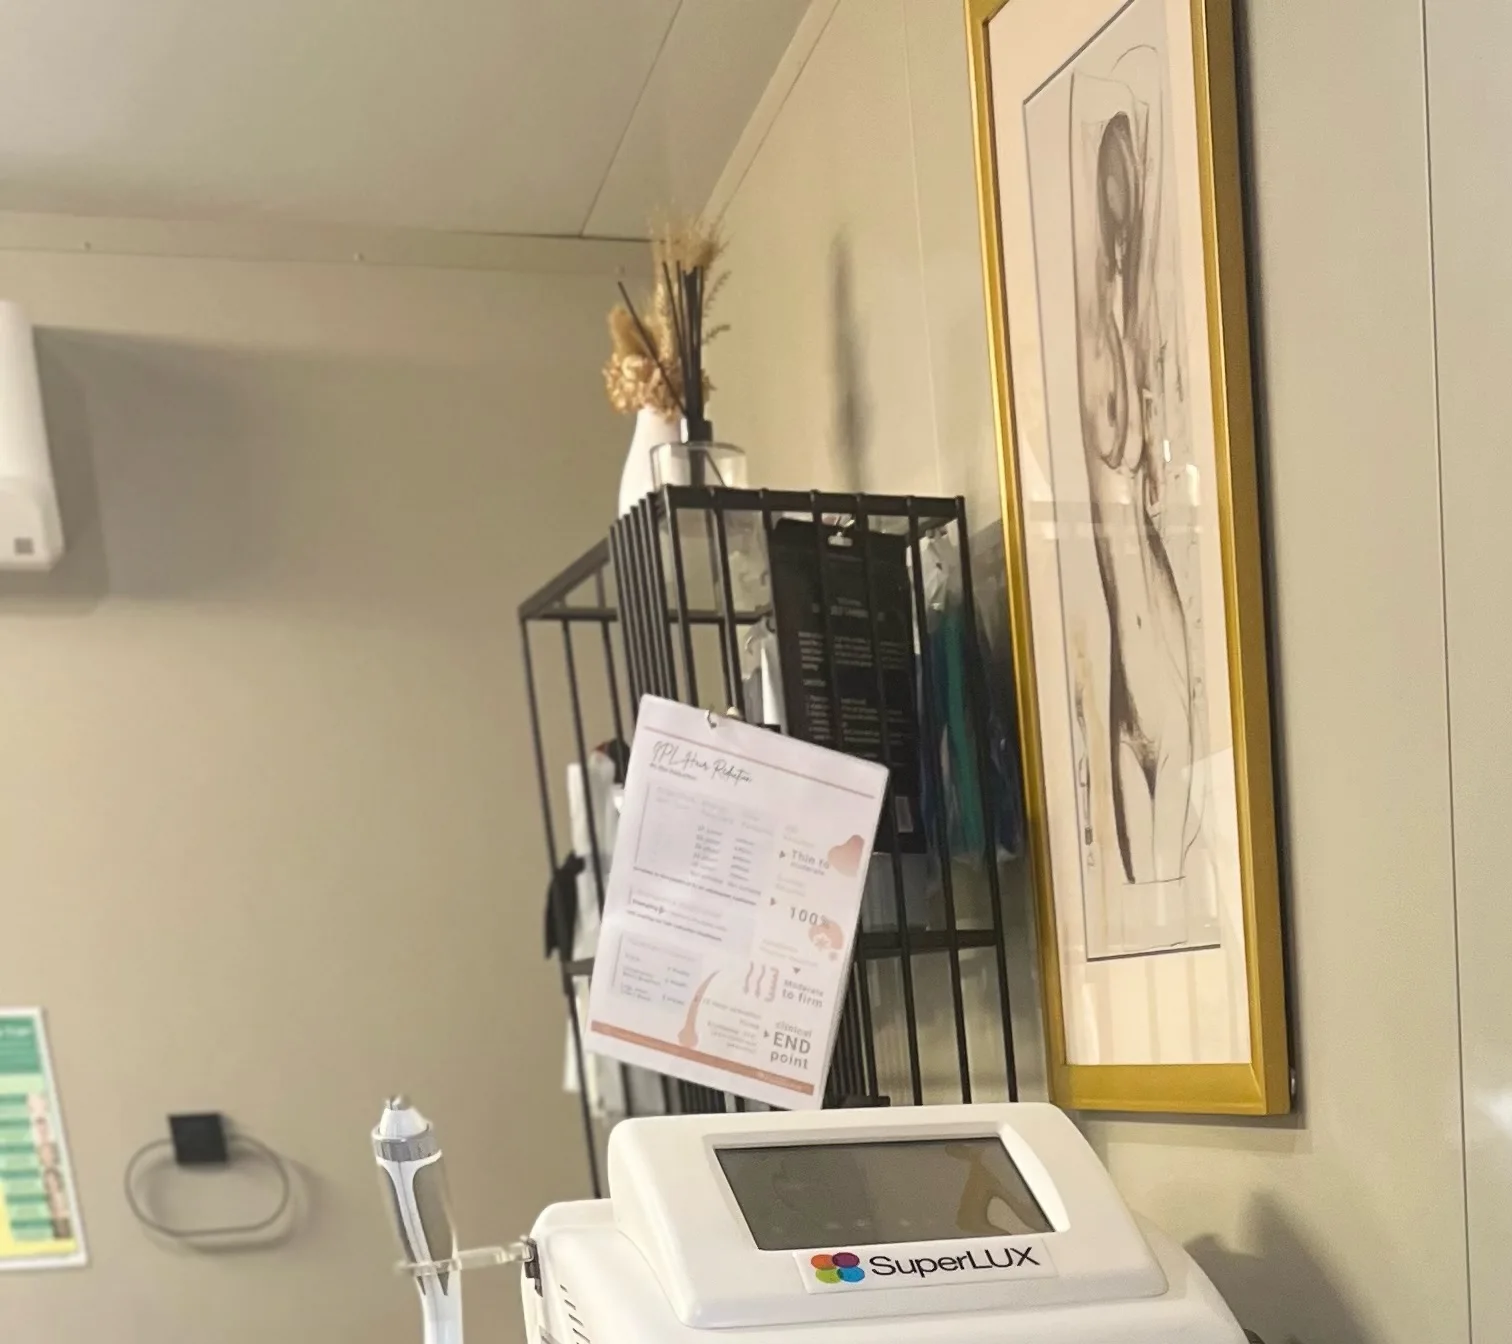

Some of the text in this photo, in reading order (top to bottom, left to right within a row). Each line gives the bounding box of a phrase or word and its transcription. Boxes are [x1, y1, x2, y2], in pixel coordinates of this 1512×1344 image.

[792, 848, 830, 870] Thin to
[790, 906, 829, 931] 100%
[782, 988, 823, 1008] to firm
[775, 1020, 812, 1039] clinical
[773, 1031, 811, 1054] END
[770, 1051, 808, 1070] point
[869, 1247, 1041, 1278] SuperLUX
